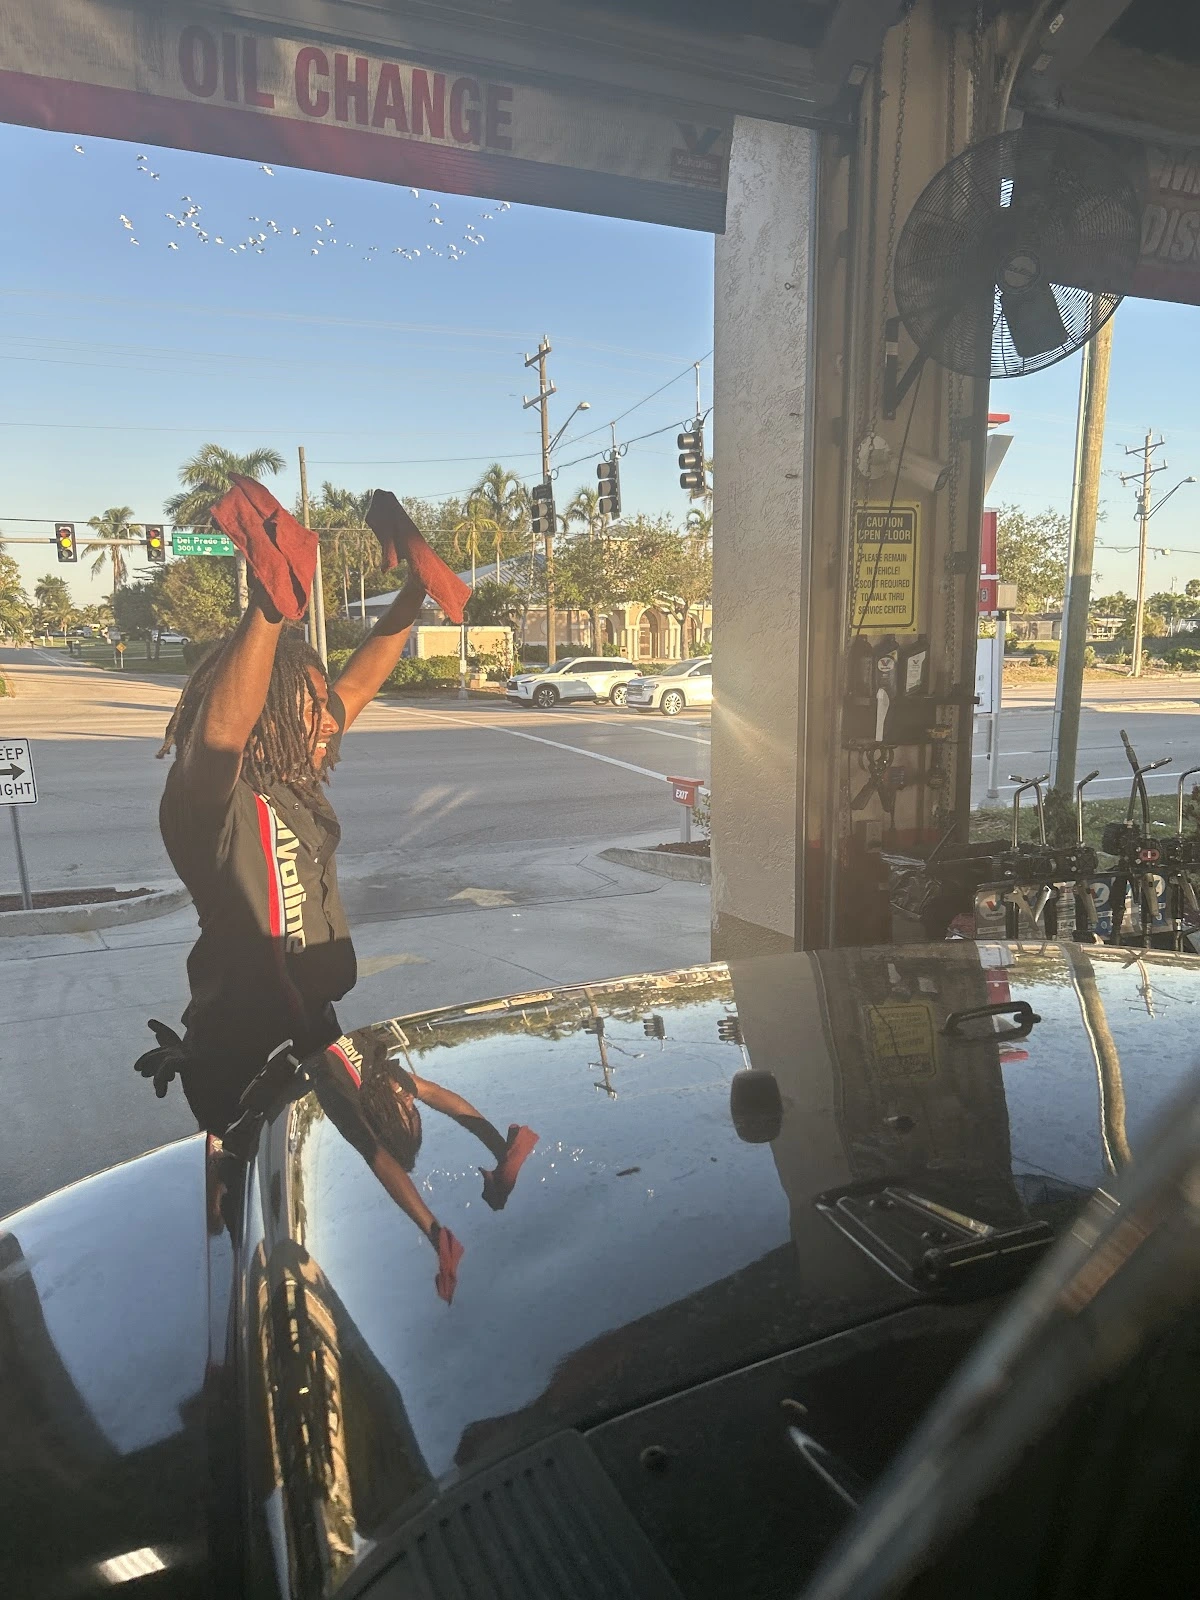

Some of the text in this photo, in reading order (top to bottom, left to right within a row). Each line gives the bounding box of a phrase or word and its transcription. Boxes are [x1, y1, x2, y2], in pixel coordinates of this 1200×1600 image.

[178, 24, 514, 151] OIL CHANGE
[1139, 203, 1200, 262] DIS
[866, 516, 903, 528] CAUTION
[858, 529, 881, 541] OPEN
[861, 554, 907, 562] PLEASE REMAIN
[866, 566, 901, 576] IN EHICLE!
[855, 579, 910, 589] SCOT REQUIRED
[861, 592, 905, 602] TO WALK THRU
[884, 605, 907, 614] CENTER
[0, 747, 24, 761] EEP
[0, 782, 32, 796] IGHT
[259, 793, 307, 954] lvoline
